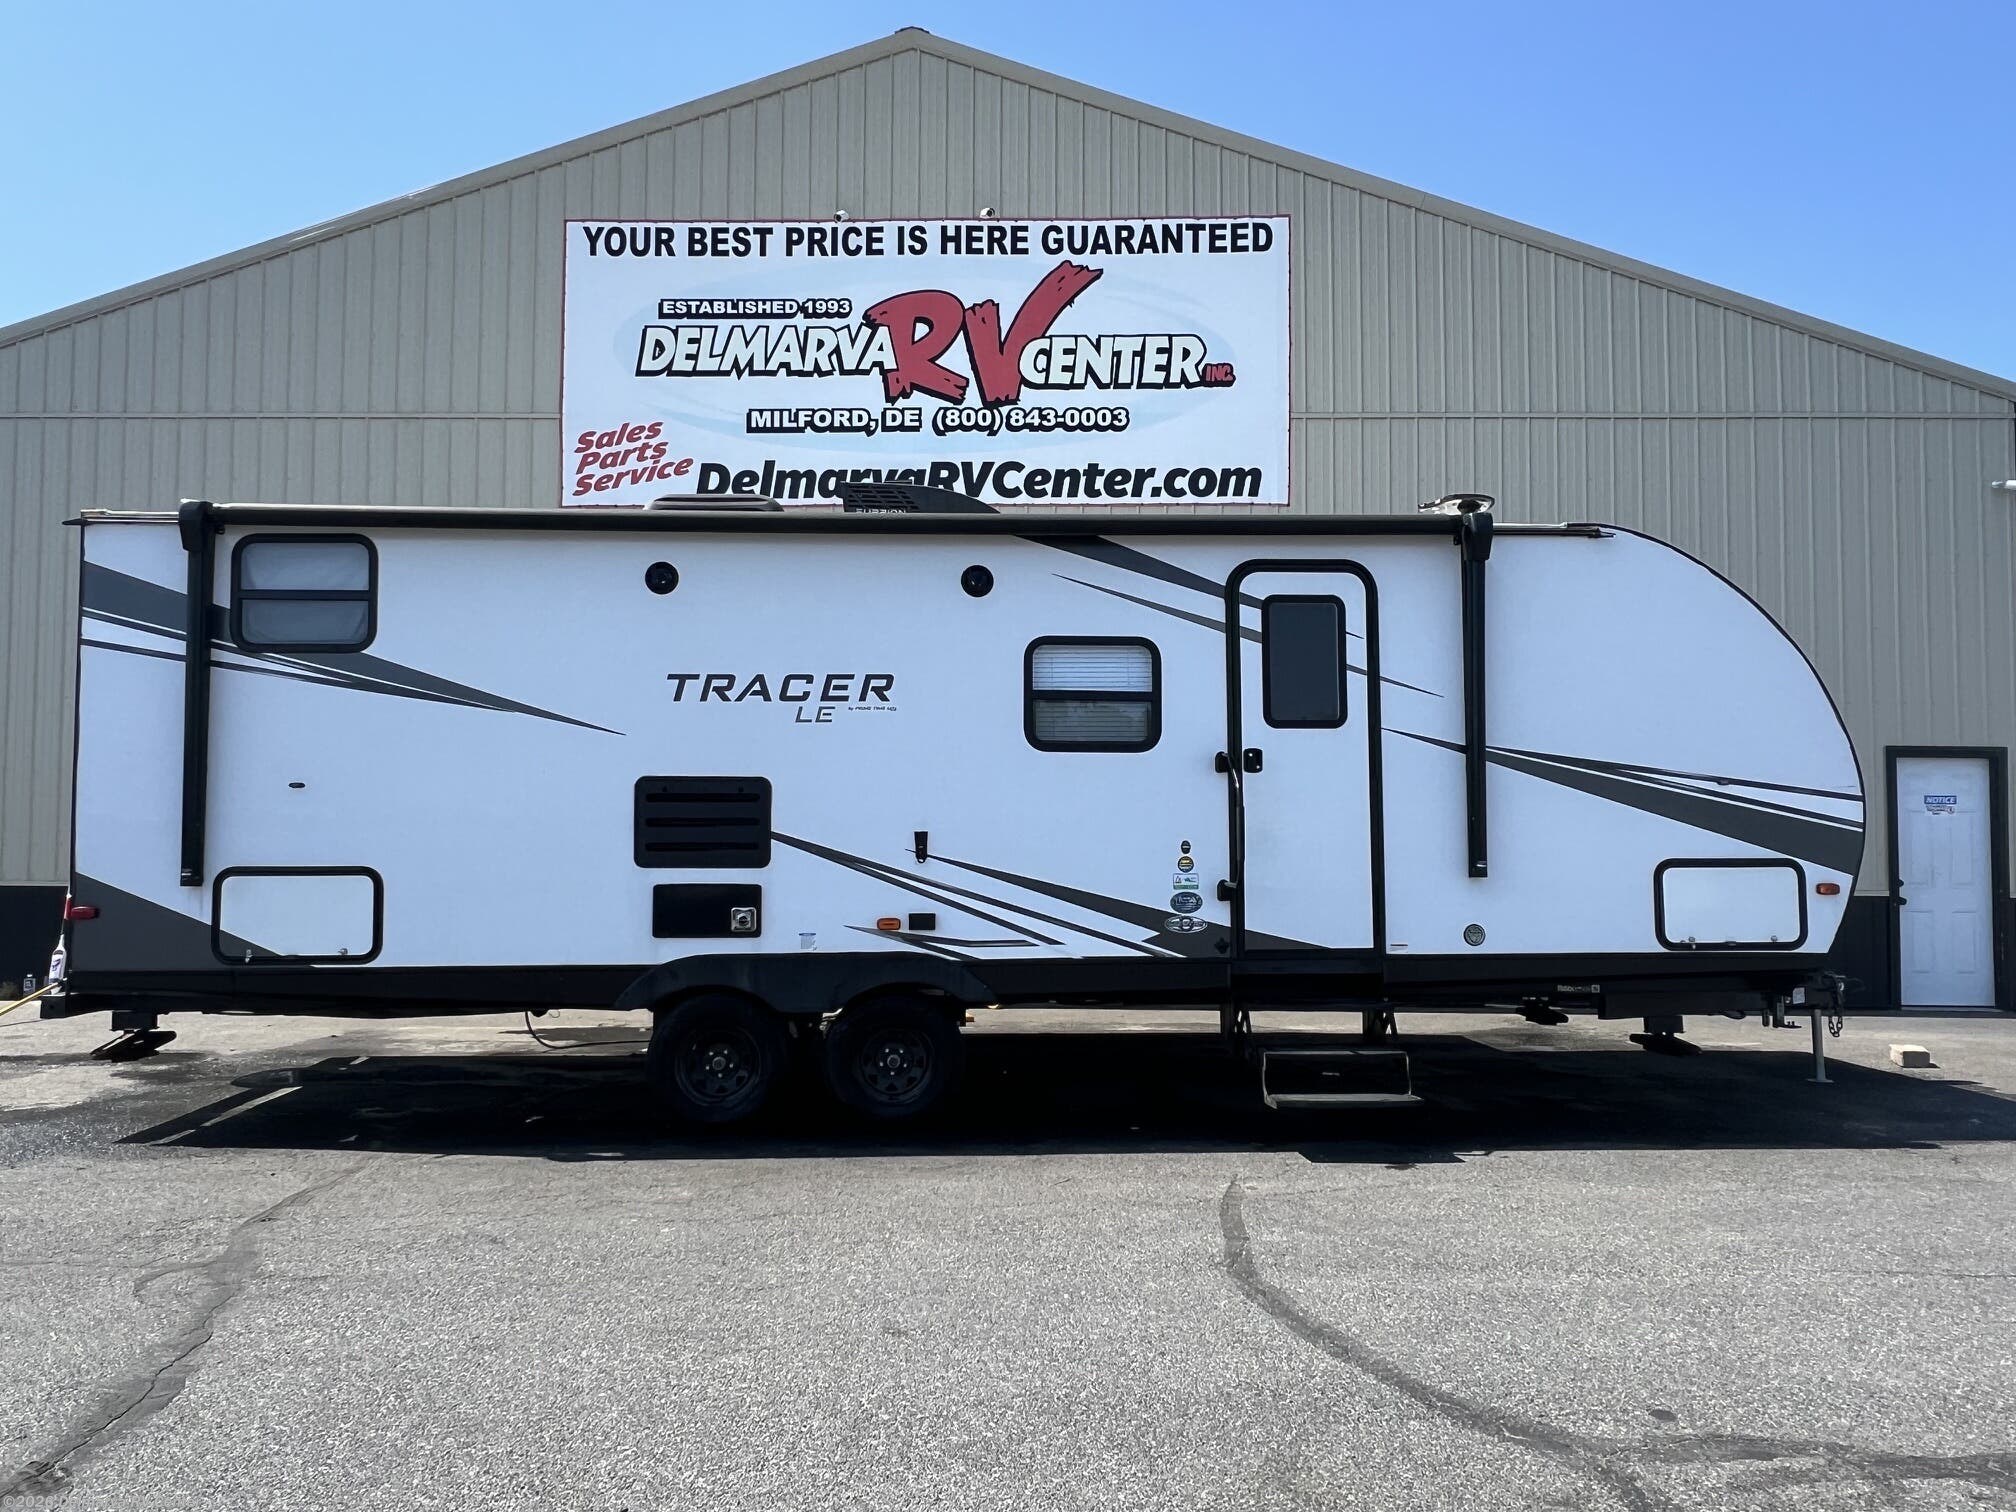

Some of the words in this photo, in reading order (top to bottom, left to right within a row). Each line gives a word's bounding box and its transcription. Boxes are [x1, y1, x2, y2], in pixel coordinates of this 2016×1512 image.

[583, 226, 676, 257] YOUR
[687, 226, 773, 257] BEST
[785, 226, 885, 257] PRICE
[897, 225, 928, 256] IS
[940, 225, 1029, 256] HERE
[1041, 223, 1273, 255] GUARANTEED
[660, 300, 799, 317] ESTABLISHED
[803, 300, 851, 317] 1993
[636, 325, 897, 378] DELMARVA
[863, 260, 1104, 406] RV
[1019, 334, 1206, 388] CENTER
[747, 409, 877, 436] MILFORD,
[882, 409, 921, 432] DE
[933, 408, 1003, 435] (800)
[1008, 408, 1130, 432] 843-0003
[574, 422, 663, 454] Sales
[577, 441, 668, 475] Parts
[573, 457, 694, 496] Service
[667, 674, 894, 702] TRACER
[795, 706, 835, 723] LE
[1925, 796, 1956, 804] NOTICE
